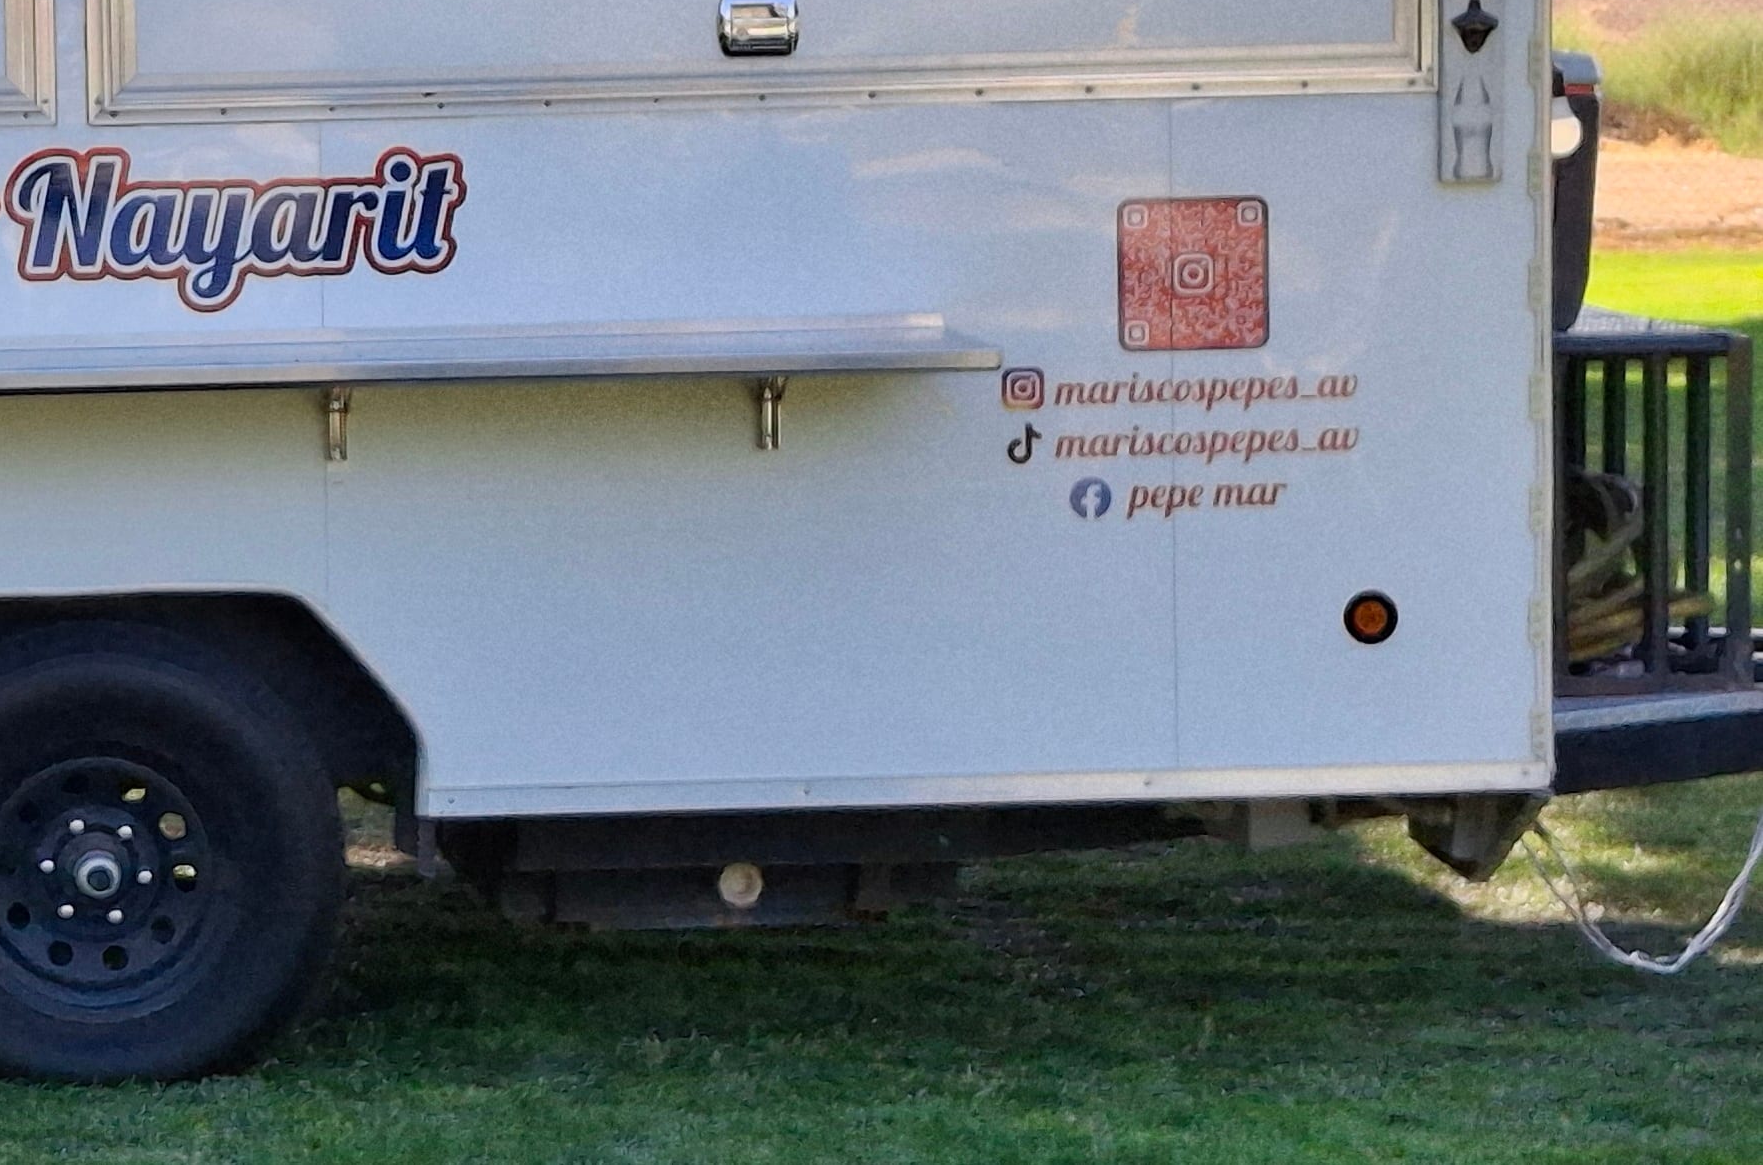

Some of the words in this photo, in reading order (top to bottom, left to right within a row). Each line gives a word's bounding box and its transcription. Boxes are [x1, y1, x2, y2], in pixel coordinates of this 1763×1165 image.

[4, 145, 467, 313] Nayarit
[1054, 372, 1358, 411] mariscospepes_av
[1055, 425, 1359, 464] mariscospepes_av
[1126, 485, 1203, 520] pepe
[1213, 483, 1287, 507] mar
